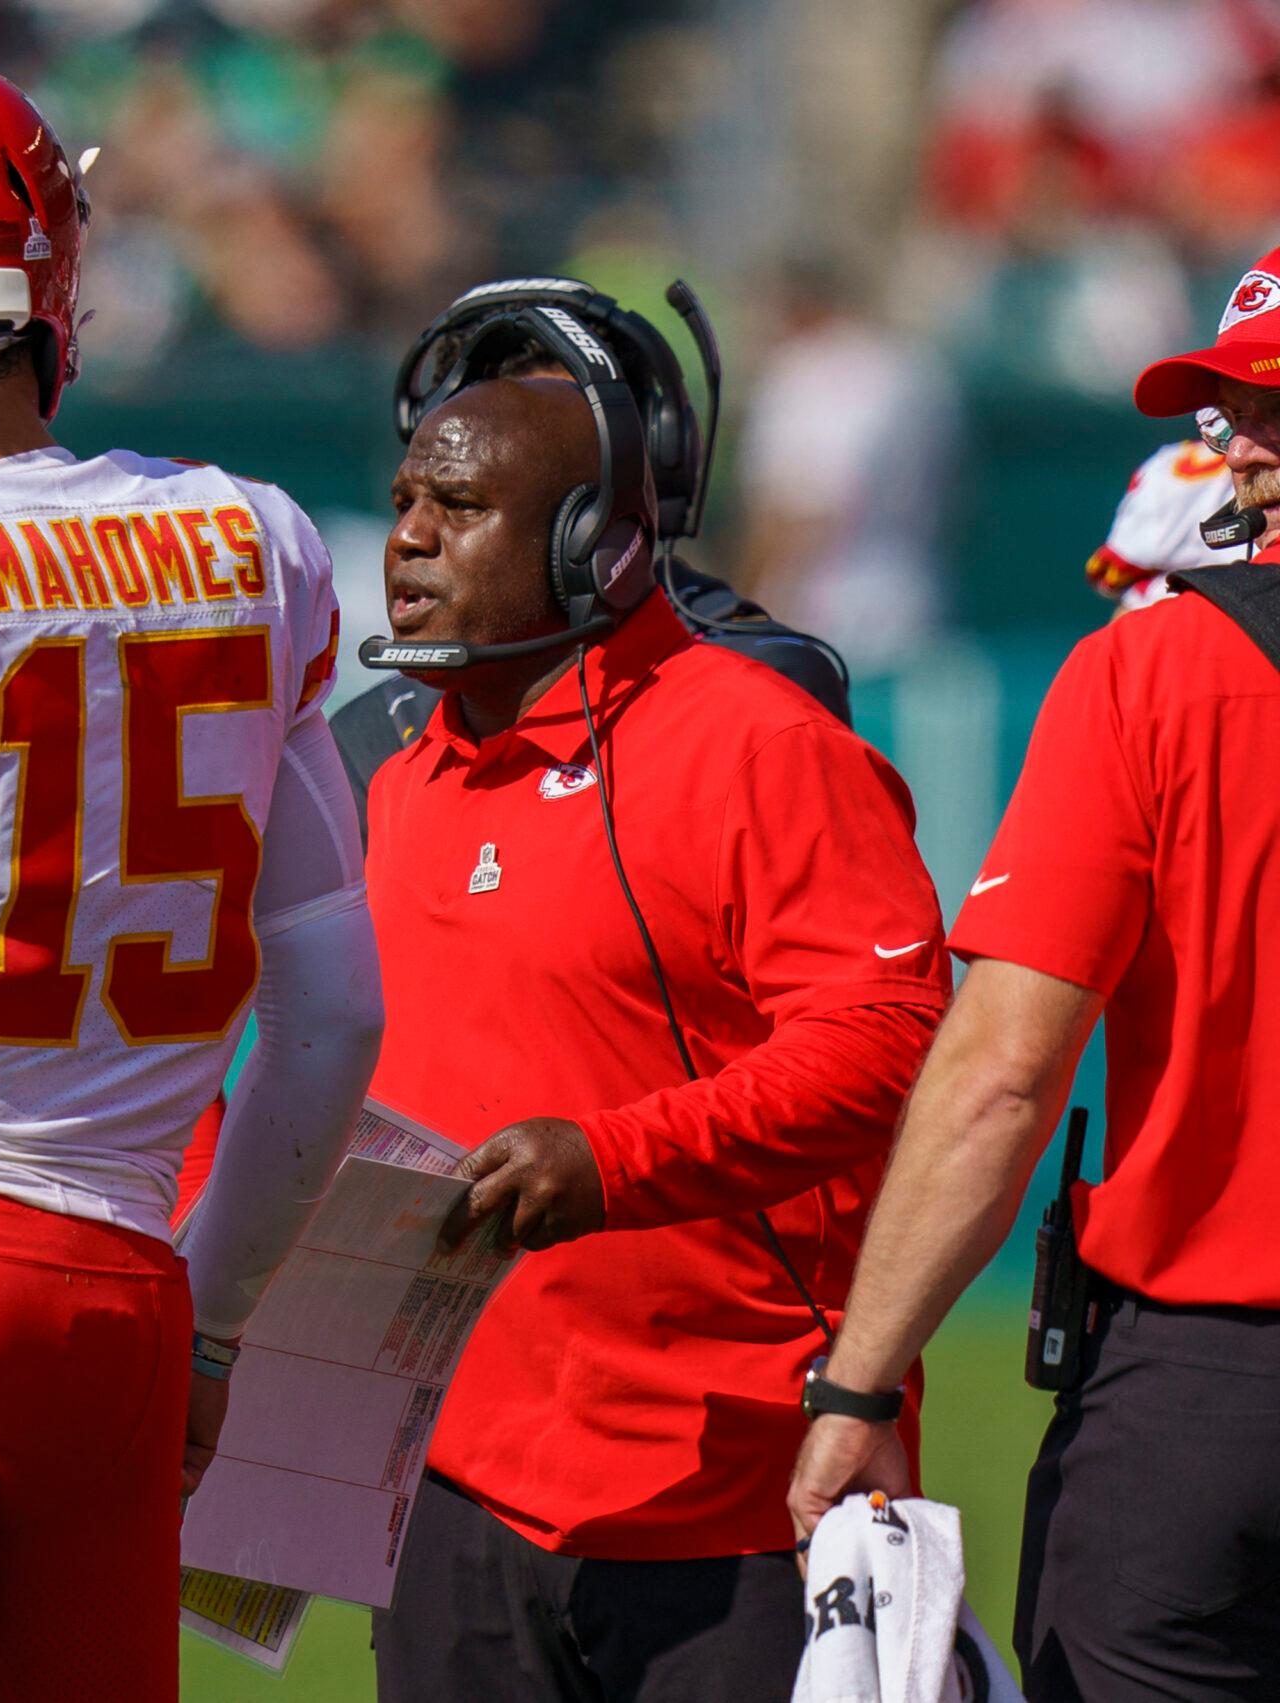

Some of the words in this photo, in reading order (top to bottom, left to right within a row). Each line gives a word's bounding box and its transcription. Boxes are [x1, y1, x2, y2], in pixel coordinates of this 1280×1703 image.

[1233, 278, 1272, 312] KC
[535, 306, 617, 380] BOSE
[1205, 524, 1240, 543] BOSE
[604, 524, 645, 590] BOSE
[368, 647, 460, 663] BOSE
